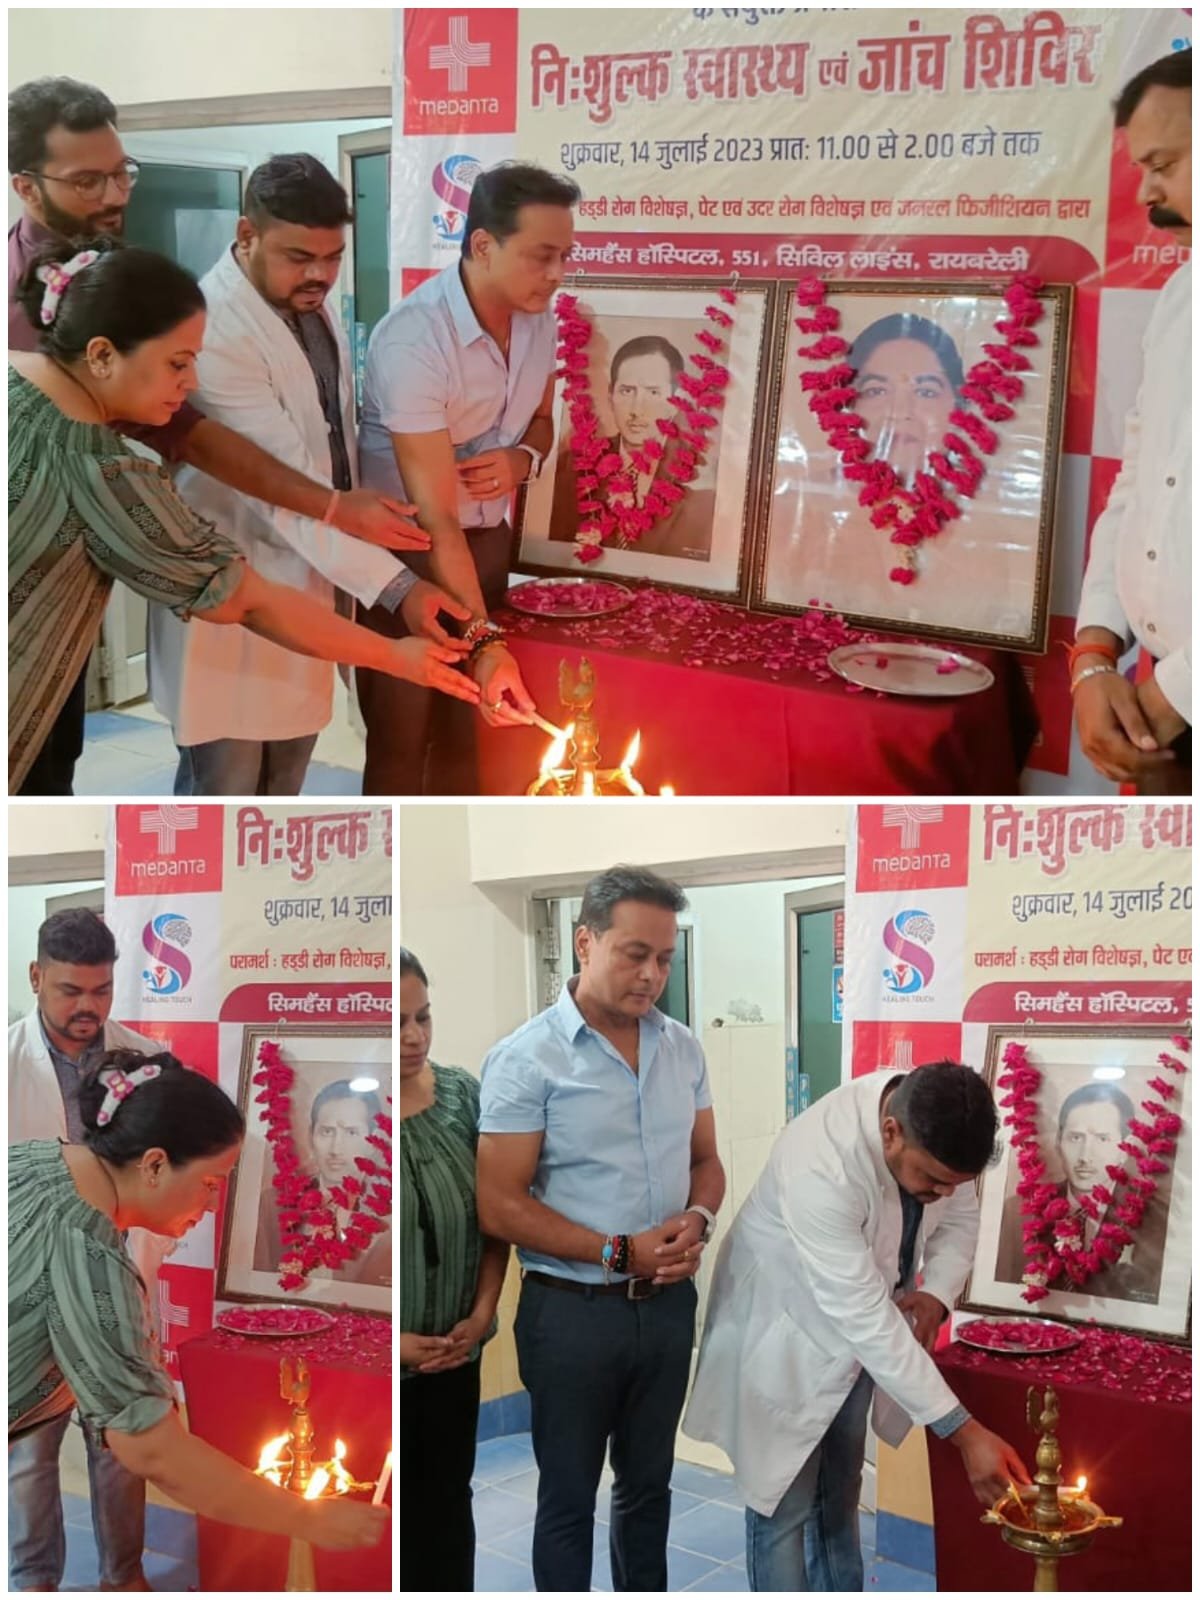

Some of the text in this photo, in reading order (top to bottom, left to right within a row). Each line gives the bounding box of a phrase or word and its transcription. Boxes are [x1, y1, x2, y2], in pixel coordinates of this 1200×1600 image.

[818, 51, 849, 87] एवं
[858, 20, 951, 92] जांच
[964, 11, 1101, 90] शिविर
[561, 140, 625, 170] शुक्रवार,
[631, 140, 649, 164] 14
[654, 133, 709, 171] जुलाई
[714, 138, 763, 161] 2023
[817, 135, 870, 160] 11.00
[876, 128, 898, 160] से
[904, 133, 954, 160] 2.00
[962, 126, 998, 157] बजे
[1003, 131, 1043, 157] तक
[612, 195, 635, 216] रोग
[640, 195, 694, 220] विशेषज्ञ,
[699, 194, 718, 217] पेट
[722, 196, 744, 217] एवं
[746, 199, 774, 217] उदर
[779, 195, 806, 217] रोग
[811, 194, 865, 221] विशेषज्ञ
[897, 199, 950, 218] जनरल
[956, 193, 1051, 218] फिजीशियन
[1057, 199, 1090, 220] द्वारा
[637, 242, 725, 267] हॉस्पिटल,
[732, 249, 768, 268] 551,
[776, 243, 844, 268] सिविल
[849, 246, 920, 271] लाइंस,
[928, 246, 1030, 272] रायबरेली
[264, 898, 325, 927] शुक्रवार,
[331, 897, 349, 918] 14
[1012, 892, 1077, 922] शुक्रवार,
[1083, 890, 1104, 913] 14
[1109, 881, 1165, 919] जुलाई
[230, 949, 270, 969] परामर्श
[313, 949, 336, 968] रोग
[975, 946, 1017, 968] परामर्श
[1063, 945, 1088, 967] रोग
[1092, 943, 1148, 969] विशेषज्ञ,
[1152, 943, 1173, 965] पेट
[1088, 991, 1179, 1015] हॉस्पिटल,
